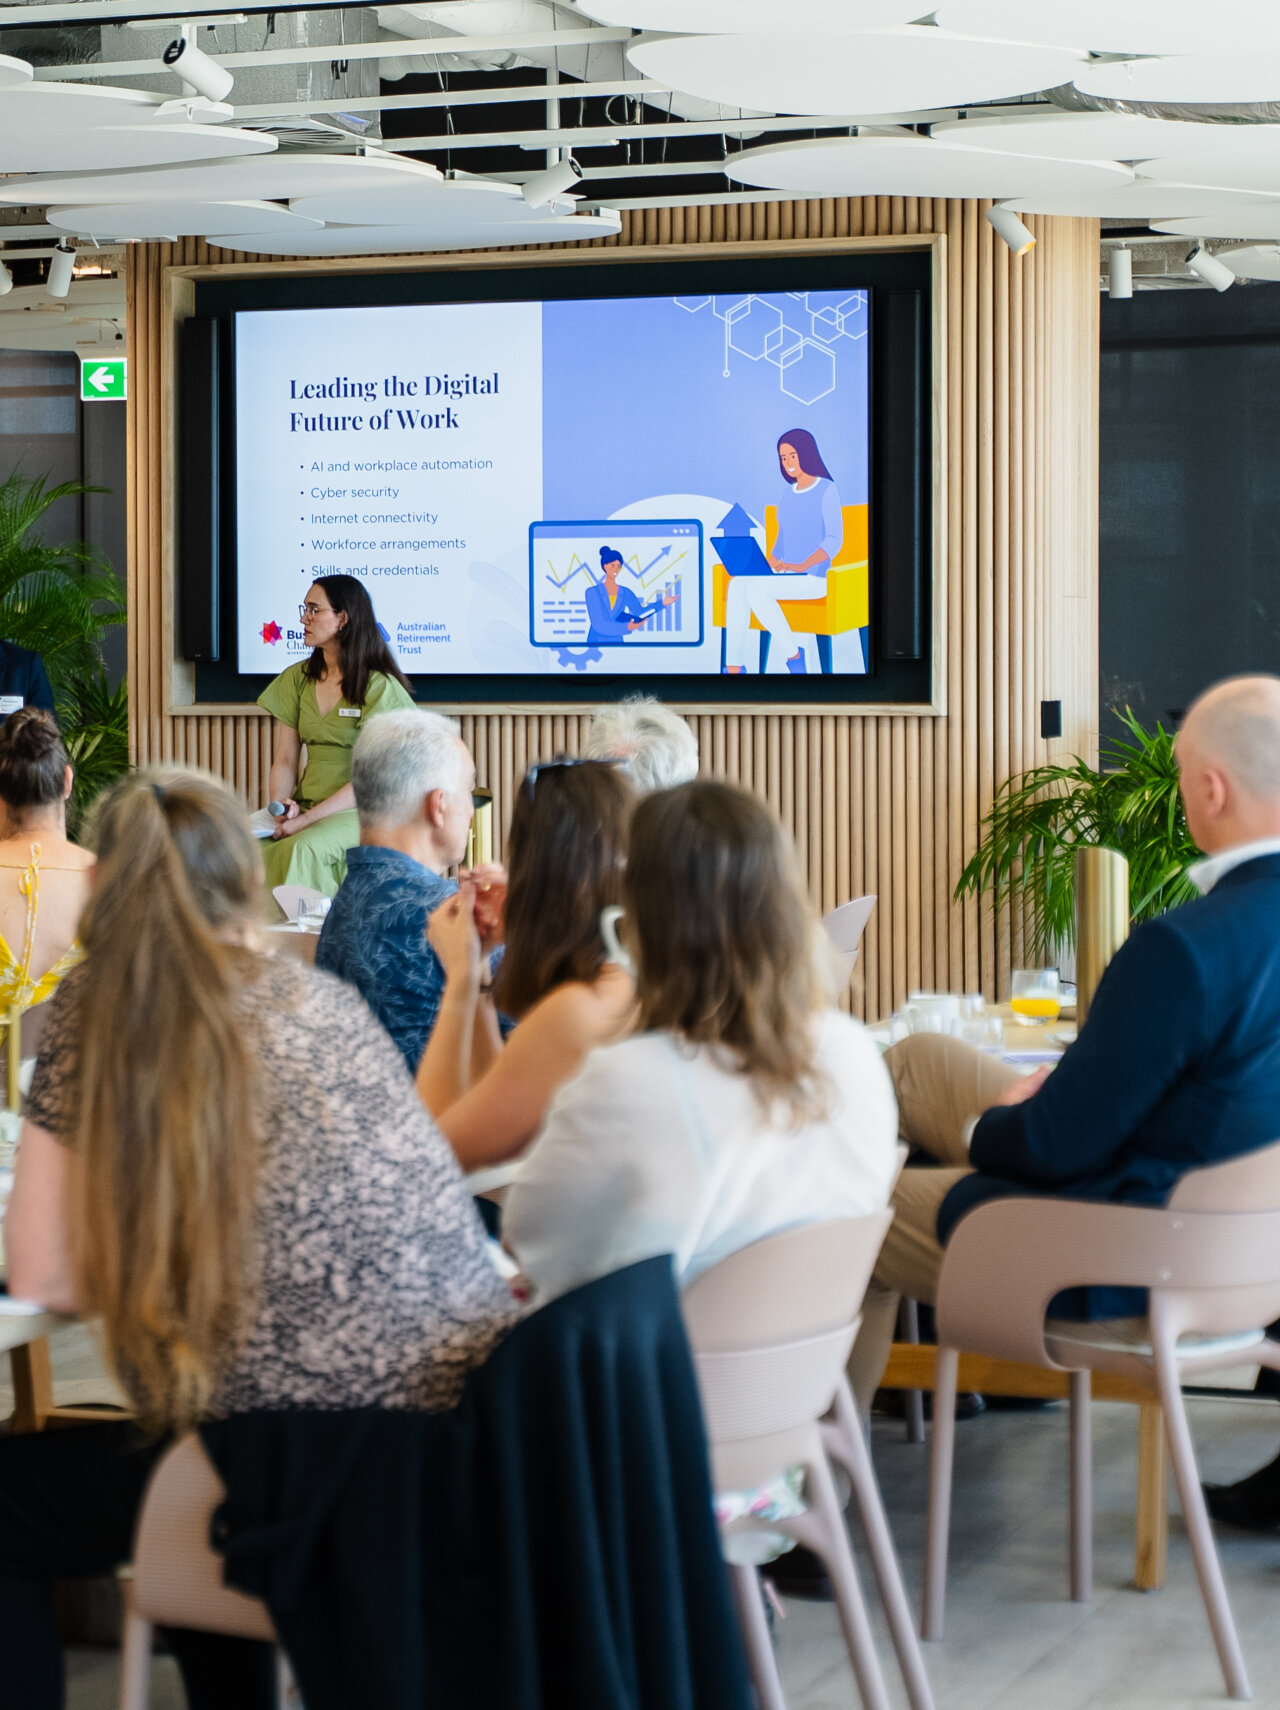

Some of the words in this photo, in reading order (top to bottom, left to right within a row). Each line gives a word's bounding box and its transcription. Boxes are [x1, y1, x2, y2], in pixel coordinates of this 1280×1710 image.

[290, 376, 378, 402] Leading
[384, 375, 417, 397] the
[425, 373, 499, 399] Digital
[290, 412, 363, 432] Future
[369, 408, 394, 430] of
[396, 407, 459, 430] Work
[311, 462, 323, 473] AI
[328, 460, 350, 472] and
[354, 459, 418, 473] workplace
[421, 458, 493, 470] automation
[311, 487, 347, 501] Cyber
[352, 486, 399, 500] security
[312, 513, 358, 524] Internet
[363, 512, 438, 525] connectivity
[312, 538, 376, 551] Workforce
[380, 538, 466, 552] arrangements
[312, 565, 341, 576] Skills
[345, 565, 368, 576] and
[372, 563, 439, 576] credentials
[397, 622, 447, 632] Australian
[397, 634, 451, 643] Retirement
[397, 645, 422, 655] Trust
